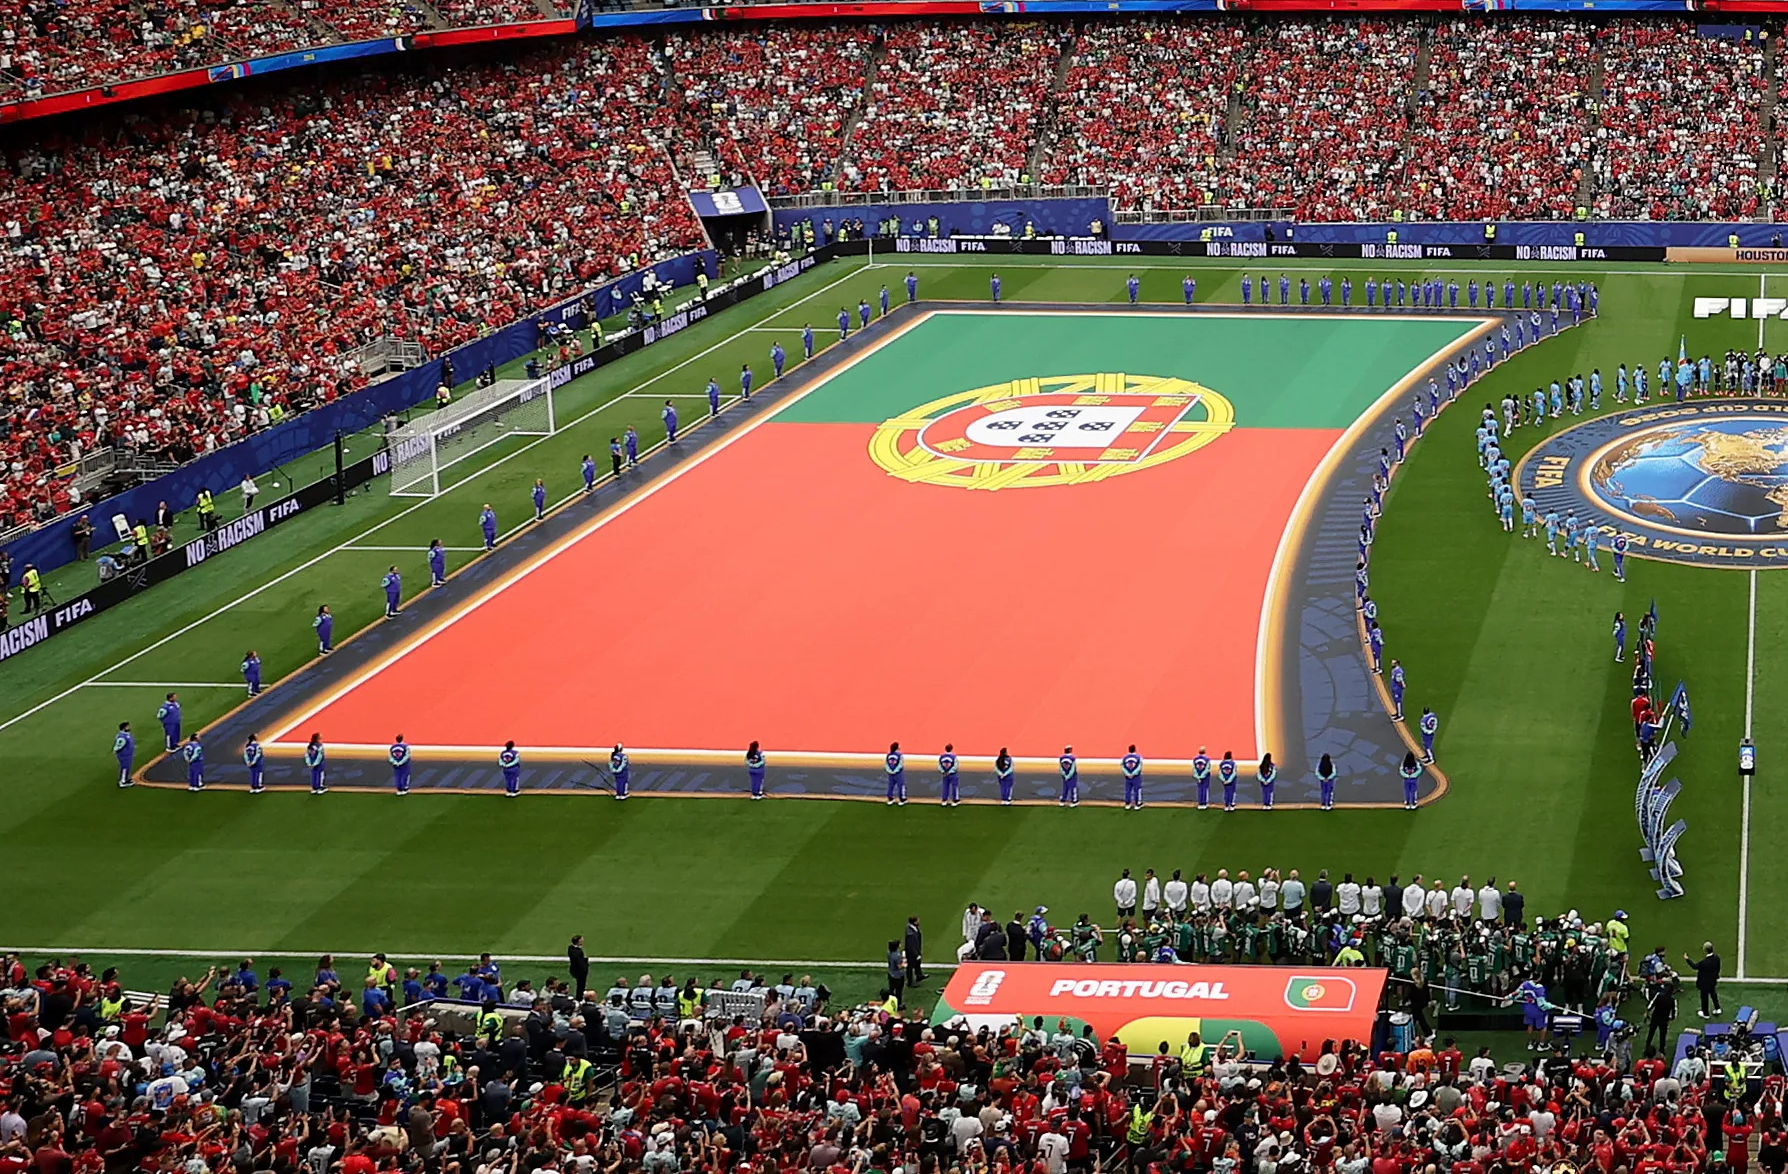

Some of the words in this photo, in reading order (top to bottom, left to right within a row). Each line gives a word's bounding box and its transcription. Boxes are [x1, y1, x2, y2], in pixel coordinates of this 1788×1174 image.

[1208, 227, 1233, 236] FIFA
[896, 239, 911, 252] NO
[920, 239, 956, 253] RACISM
[961, 242, 985, 251] FIFA
[1051, 241, 1066, 254] NO
[1075, 241, 1112, 255] RACISM
[1117, 244, 1141, 252] FIFA
[1207, 243, 1222, 256] NO
[1230, 243, 1267, 257] RACISM
[1272, 245, 1296, 254] FIFA
[1362, 244, 1376, 257] NO
[1385, 244, 1422, 258] RACISM
[1426, 247, 1451, 256] FIFA
[1516, 246, 1531, 259] NO
[1540, 246, 1576, 260] RACISM
[1581, 249, 1605, 258] FIFA
[644, 329, 655, 345] NO
[661, 312, 687, 337] RACISM
[690, 306, 708, 322] FIFA
[574, 358, 594, 374] FIFA
[1619, 404, 1700, 426] 2026
[1702, 404, 1748, 413] CUP
[1535, 456, 1571, 489] FIFA
[186, 544, 205, 568] NO
[218, 511, 264, 552] RACISM
[270, 498, 300, 522] FIFA
[1652, 536, 1754, 557] WORLD
[55, 598, 93, 627] FIFA
[1049, 979, 1229, 1000] PORTUGAL
